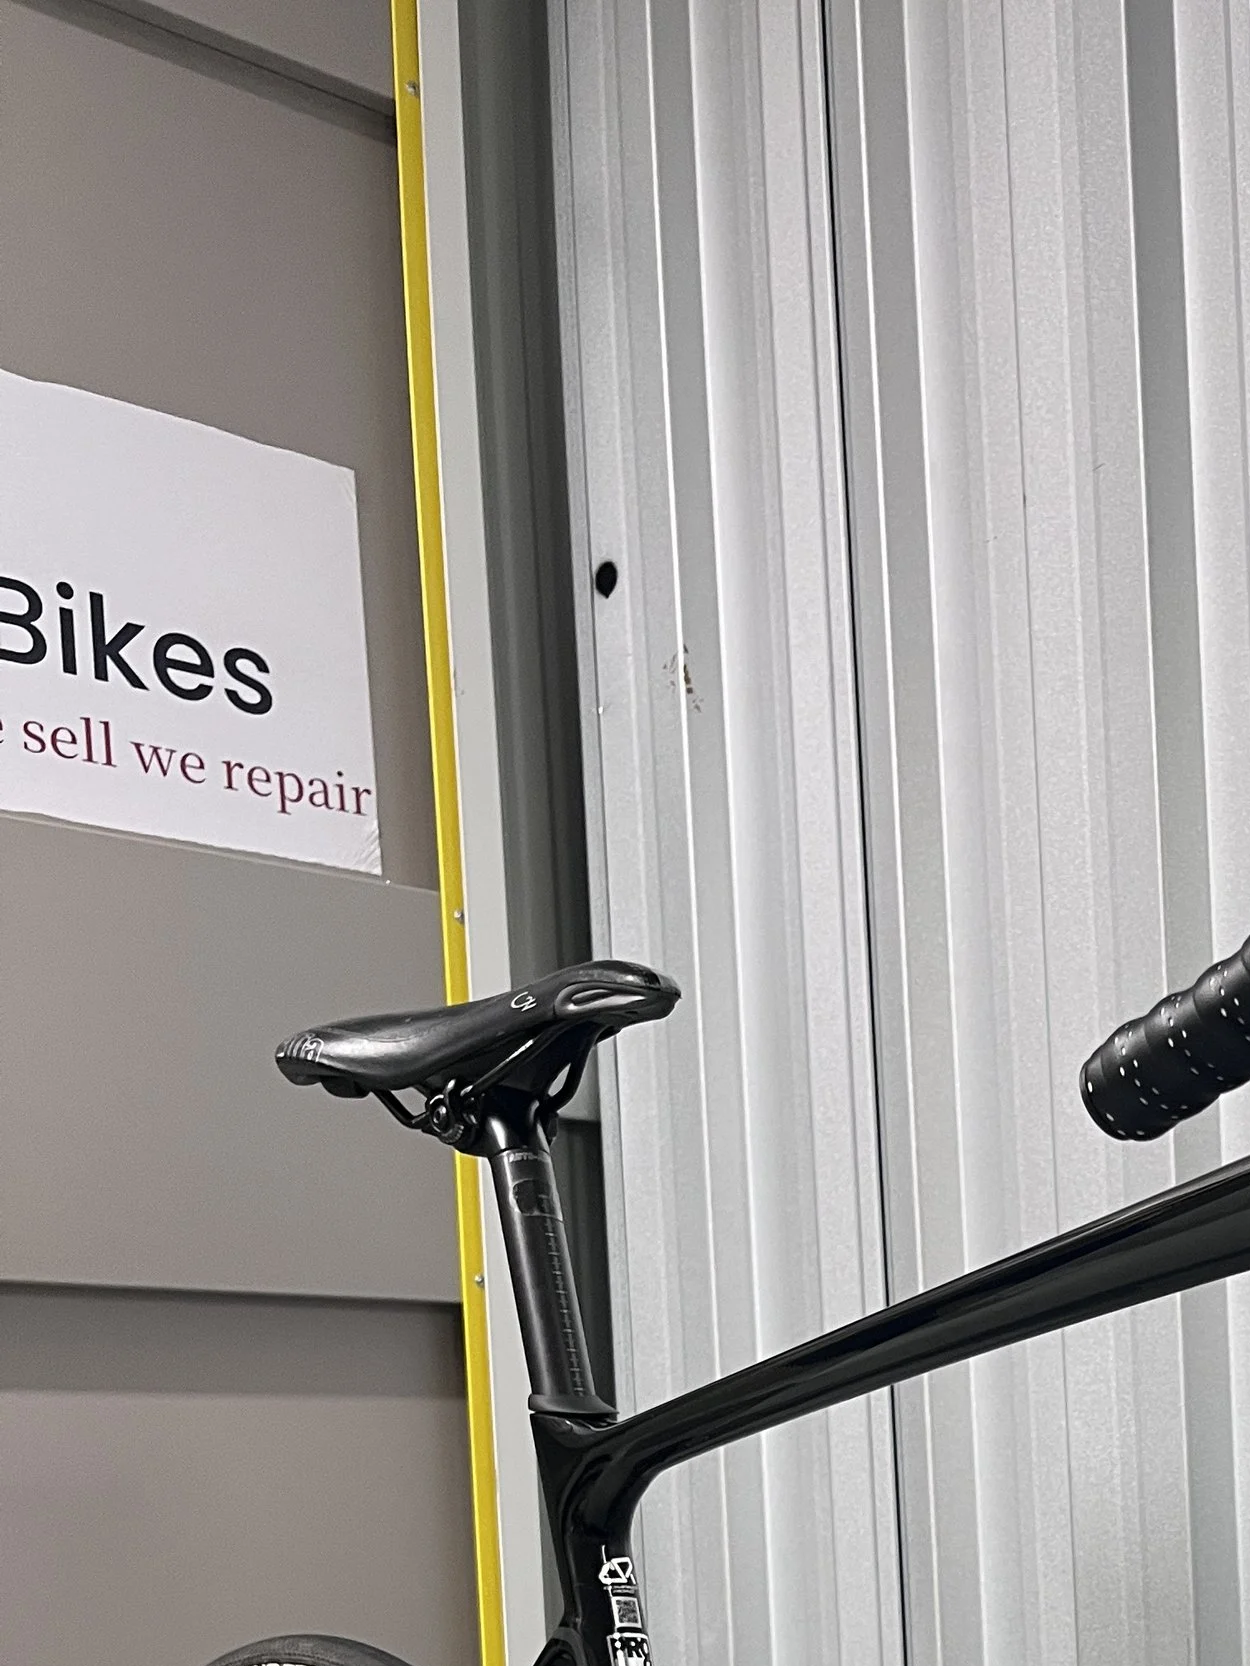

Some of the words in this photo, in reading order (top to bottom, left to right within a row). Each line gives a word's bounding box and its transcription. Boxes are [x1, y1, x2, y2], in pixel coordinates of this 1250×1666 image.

[0, 576, 273, 715] Bikes
[22, 717, 117, 768] sell
[130, 738, 206, 784] we
[222, 759, 372, 815] repair
